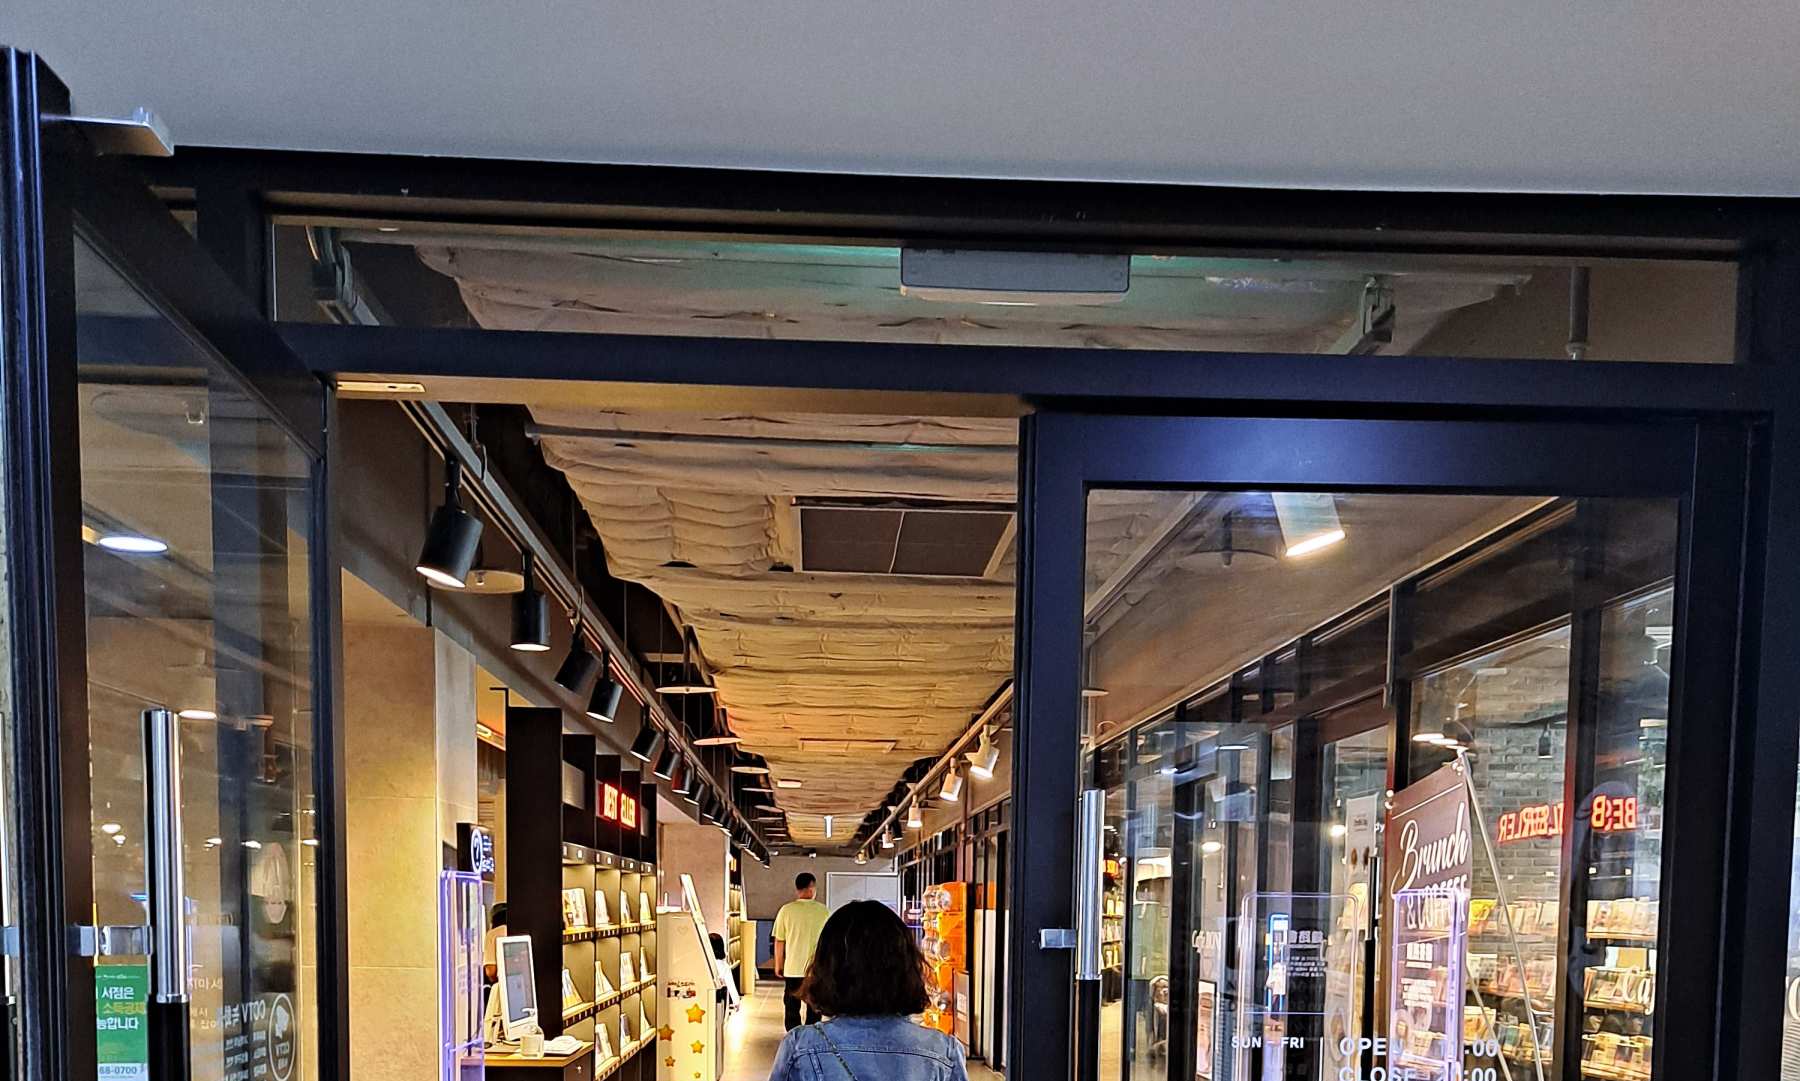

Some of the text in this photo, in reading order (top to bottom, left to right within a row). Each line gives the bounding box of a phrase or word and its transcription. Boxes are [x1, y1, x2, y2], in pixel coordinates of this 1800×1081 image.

[1391, 802, 1468, 900] Brunch
[1231, 1036, 1262, 1049] SUN
[1280, 1036, 1304, 1049] FRI
